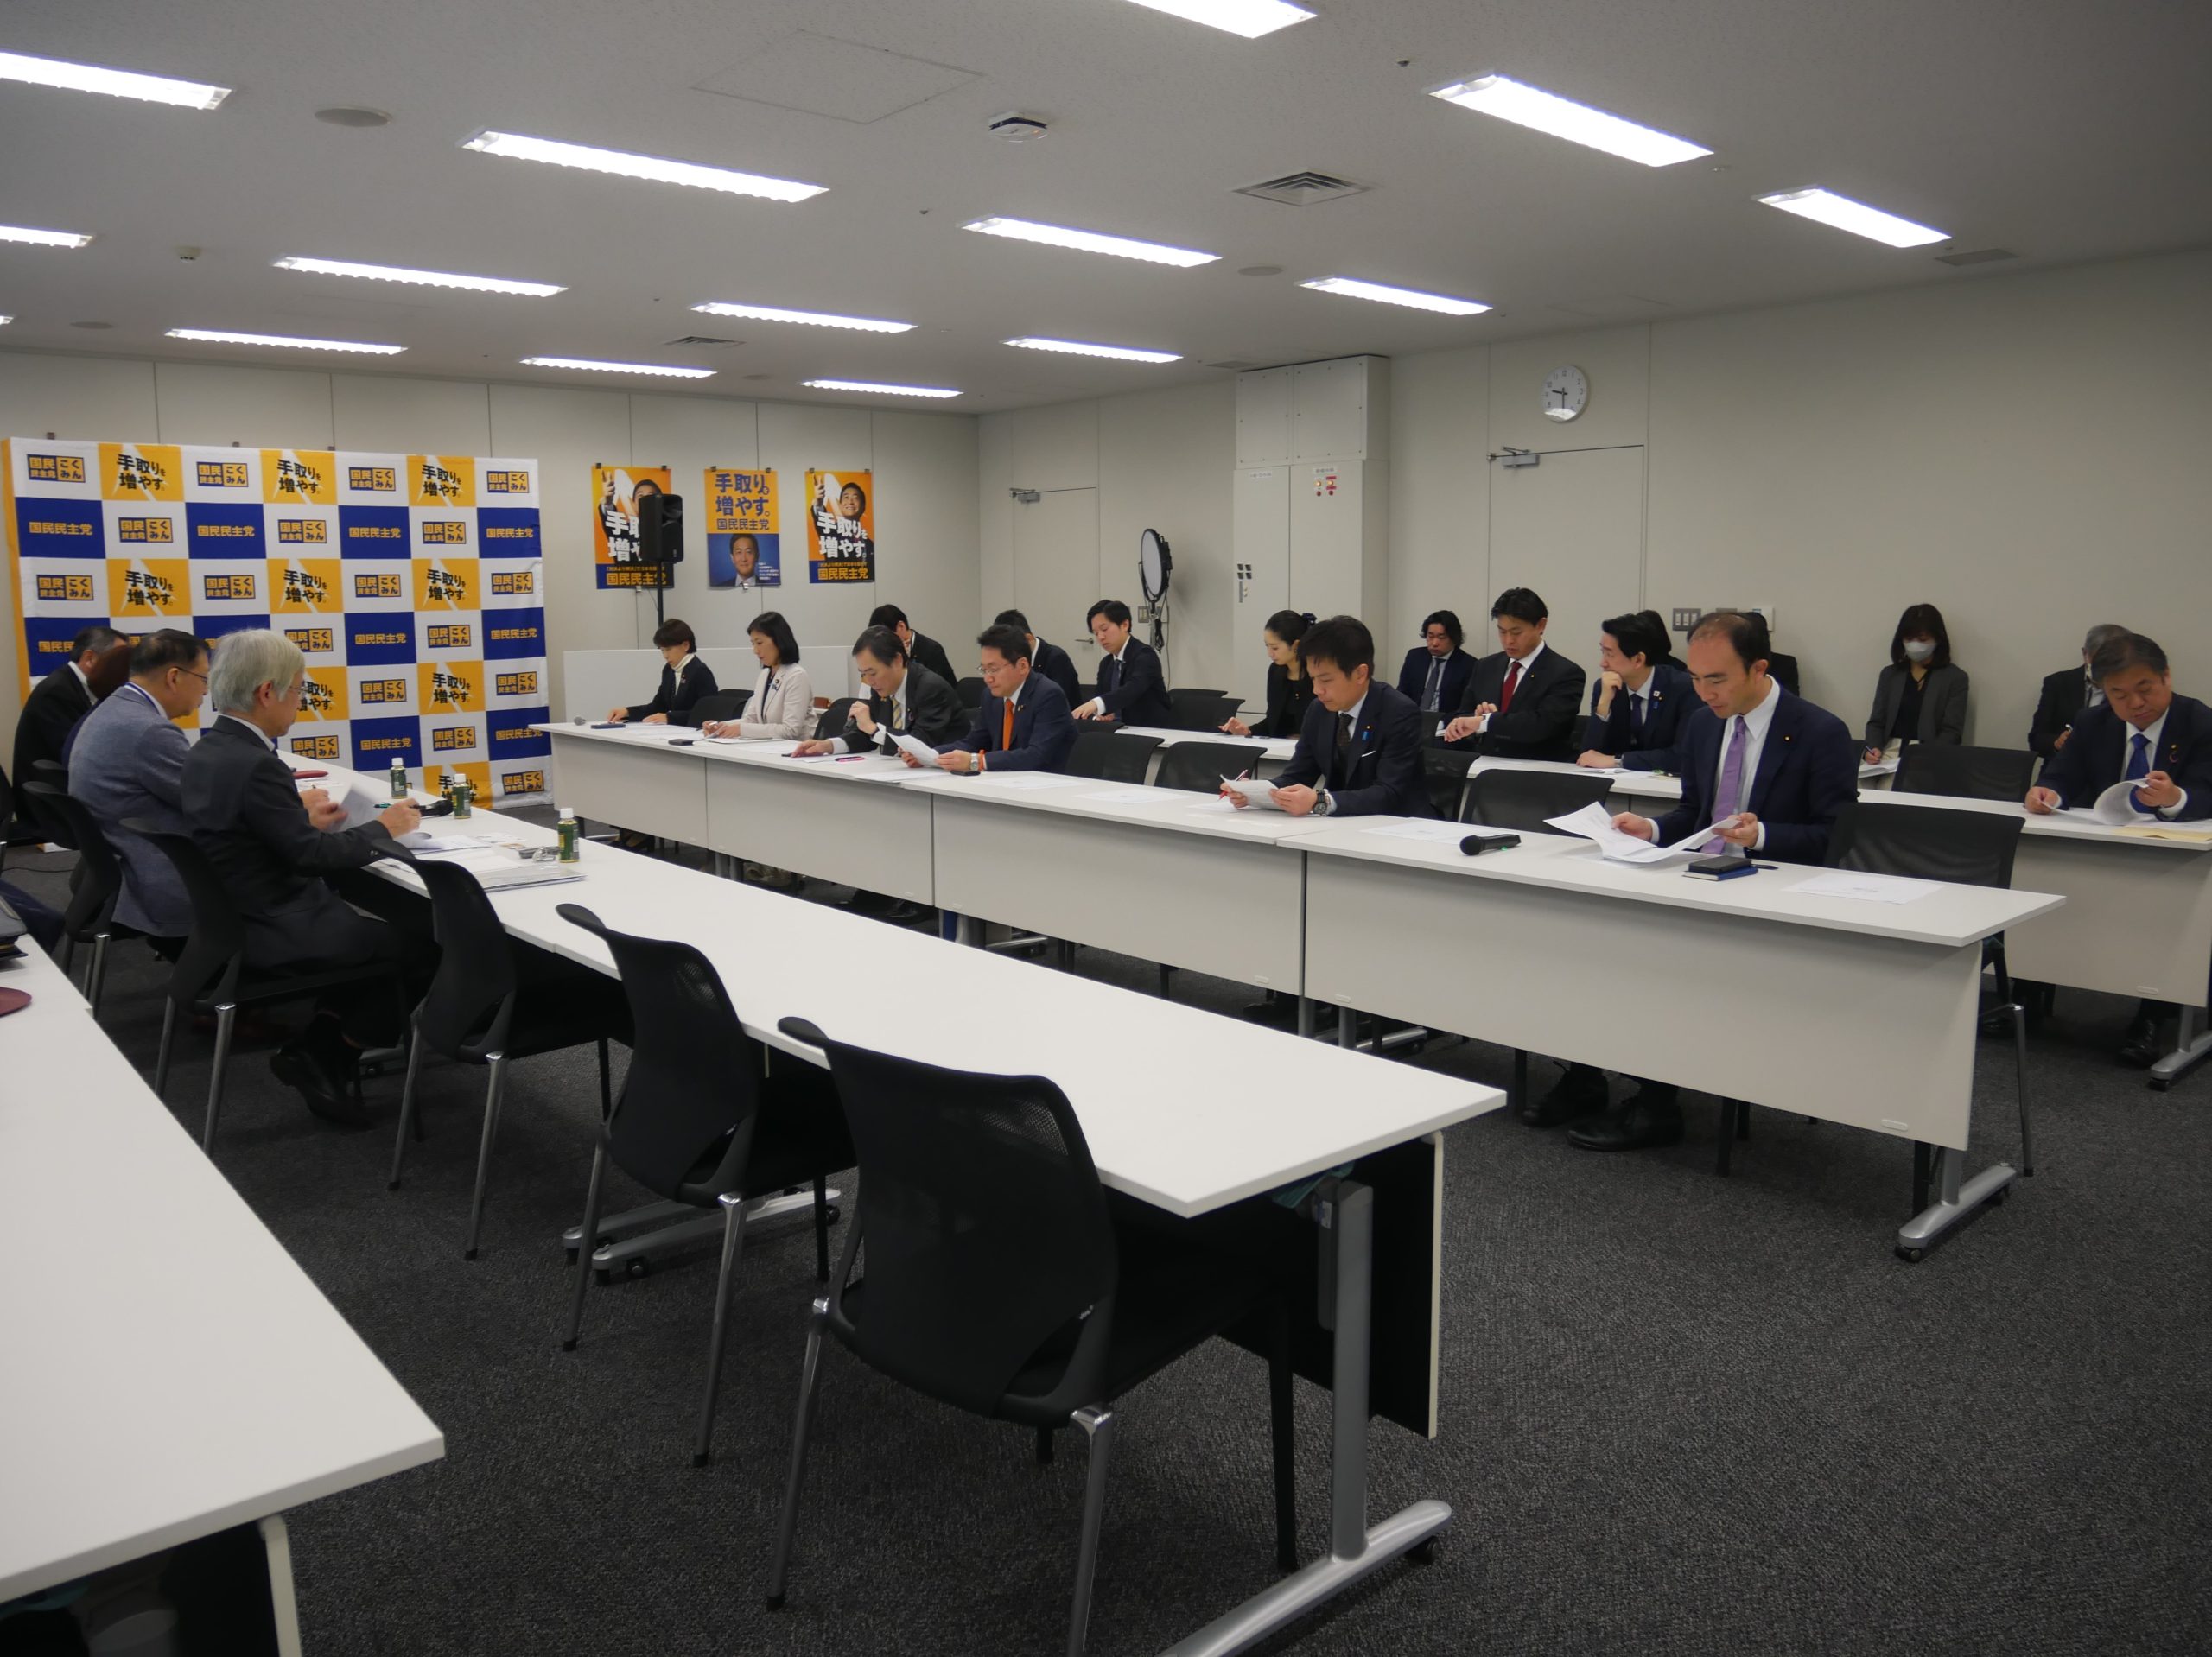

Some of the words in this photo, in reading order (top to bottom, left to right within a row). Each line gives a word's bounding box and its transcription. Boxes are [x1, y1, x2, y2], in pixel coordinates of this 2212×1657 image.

[60, 460, 80, 469] こく
[60, 470, 82, 479] みん
[226, 466, 244, 474] こく
[226, 476, 245, 485] みん
[715, 495, 770, 516] 増やす。
[29, 522, 92, 536] 国民民主党
[150, 521, 168, 530] こく
[306, 523, 322, 531] こく
[605, 510, 639, 538] 手取
[716, 518, 770, 530] 国民民主党
[817, 511, 868, 539] 手取りを
[150, 531, 170, 540] みん
[197, 525, 255, 537] 国民民主党
[349, 527, 401, 538] 国民民主党
[486, 528, 534, 538] 国民民主党
[607, 536, 642, 562] 増や
[818, 568, 868, 581] 国民民主党
[69, 579, 89, 587] こく
[234, 578, 251, 587] こく
[70, 589, 91, 598] みん
[234, 587, 252, 596] みん
[355, 633, 406, 644] 国民民主党
[491, 628, 537, 639] 国民民主党
[39, 641, 74, 652] 国民民
[306, 682, 334, 697] 取りを
[387, 691, 404, 700] みん
[319, 739, 334, 747] こく
[360, 738, 411, 750] 国民民主党
[319, 748, 336, 757] みん
